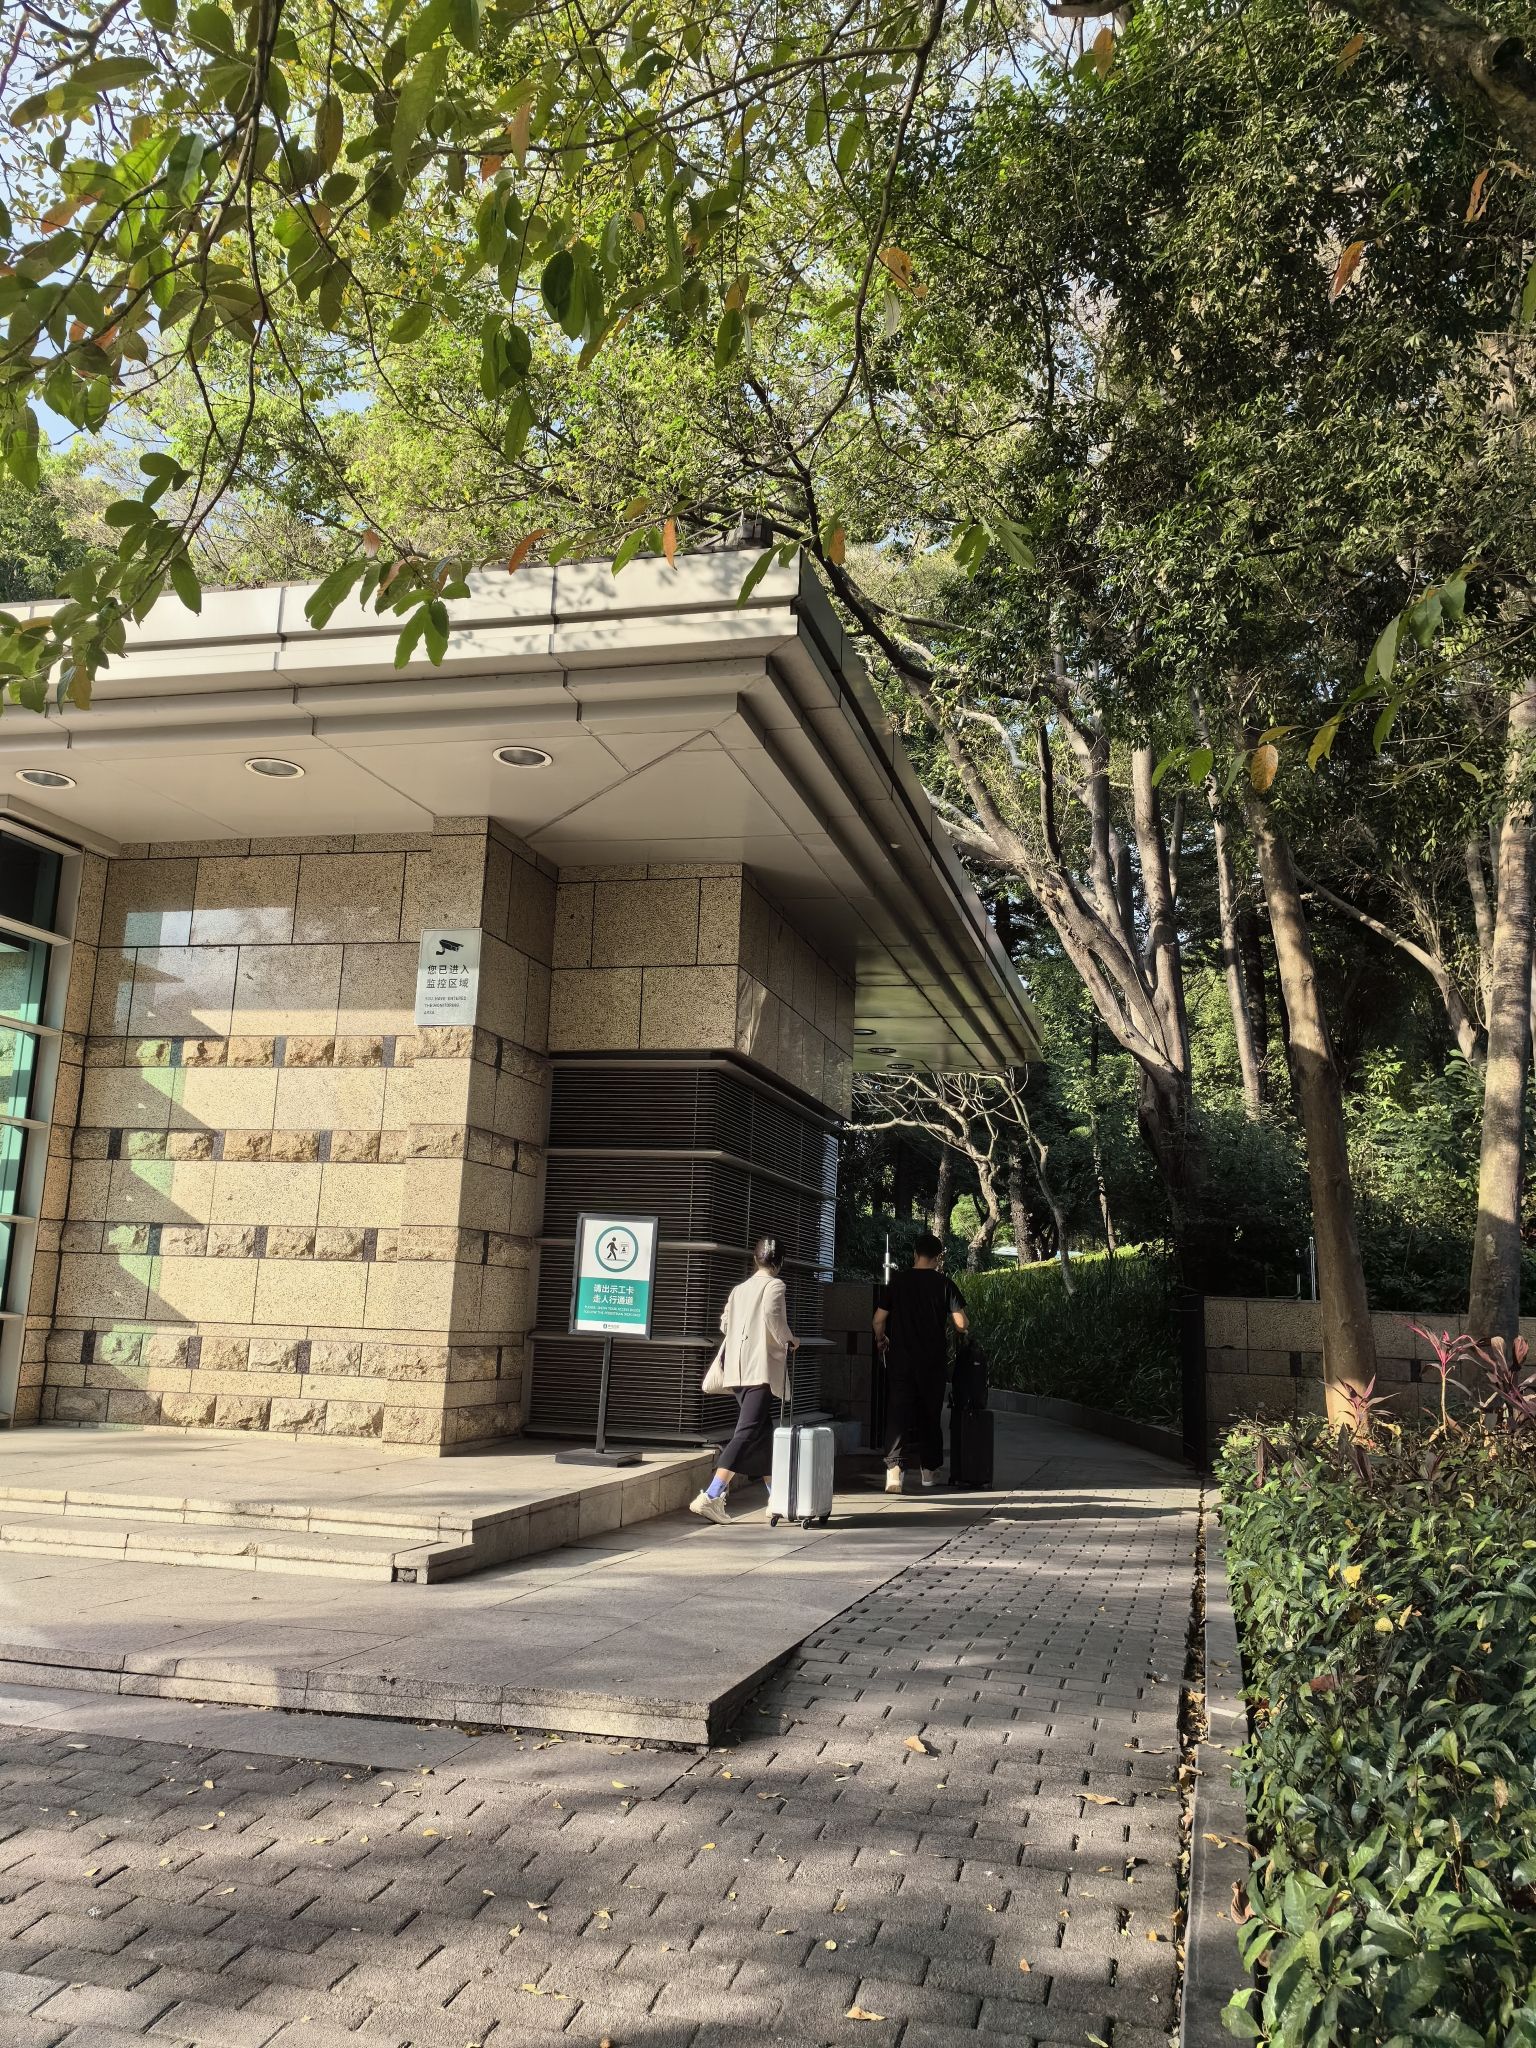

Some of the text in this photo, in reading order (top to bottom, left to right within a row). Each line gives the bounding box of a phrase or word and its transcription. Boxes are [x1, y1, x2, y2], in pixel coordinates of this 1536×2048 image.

[428, 964, 469, 975] 您已进入
[426, 978, 469, 988] 监控区域
[593, 1283, 635, 1295] 请出示工卡
[592, 1294, 634, 1305] 走人行通道
